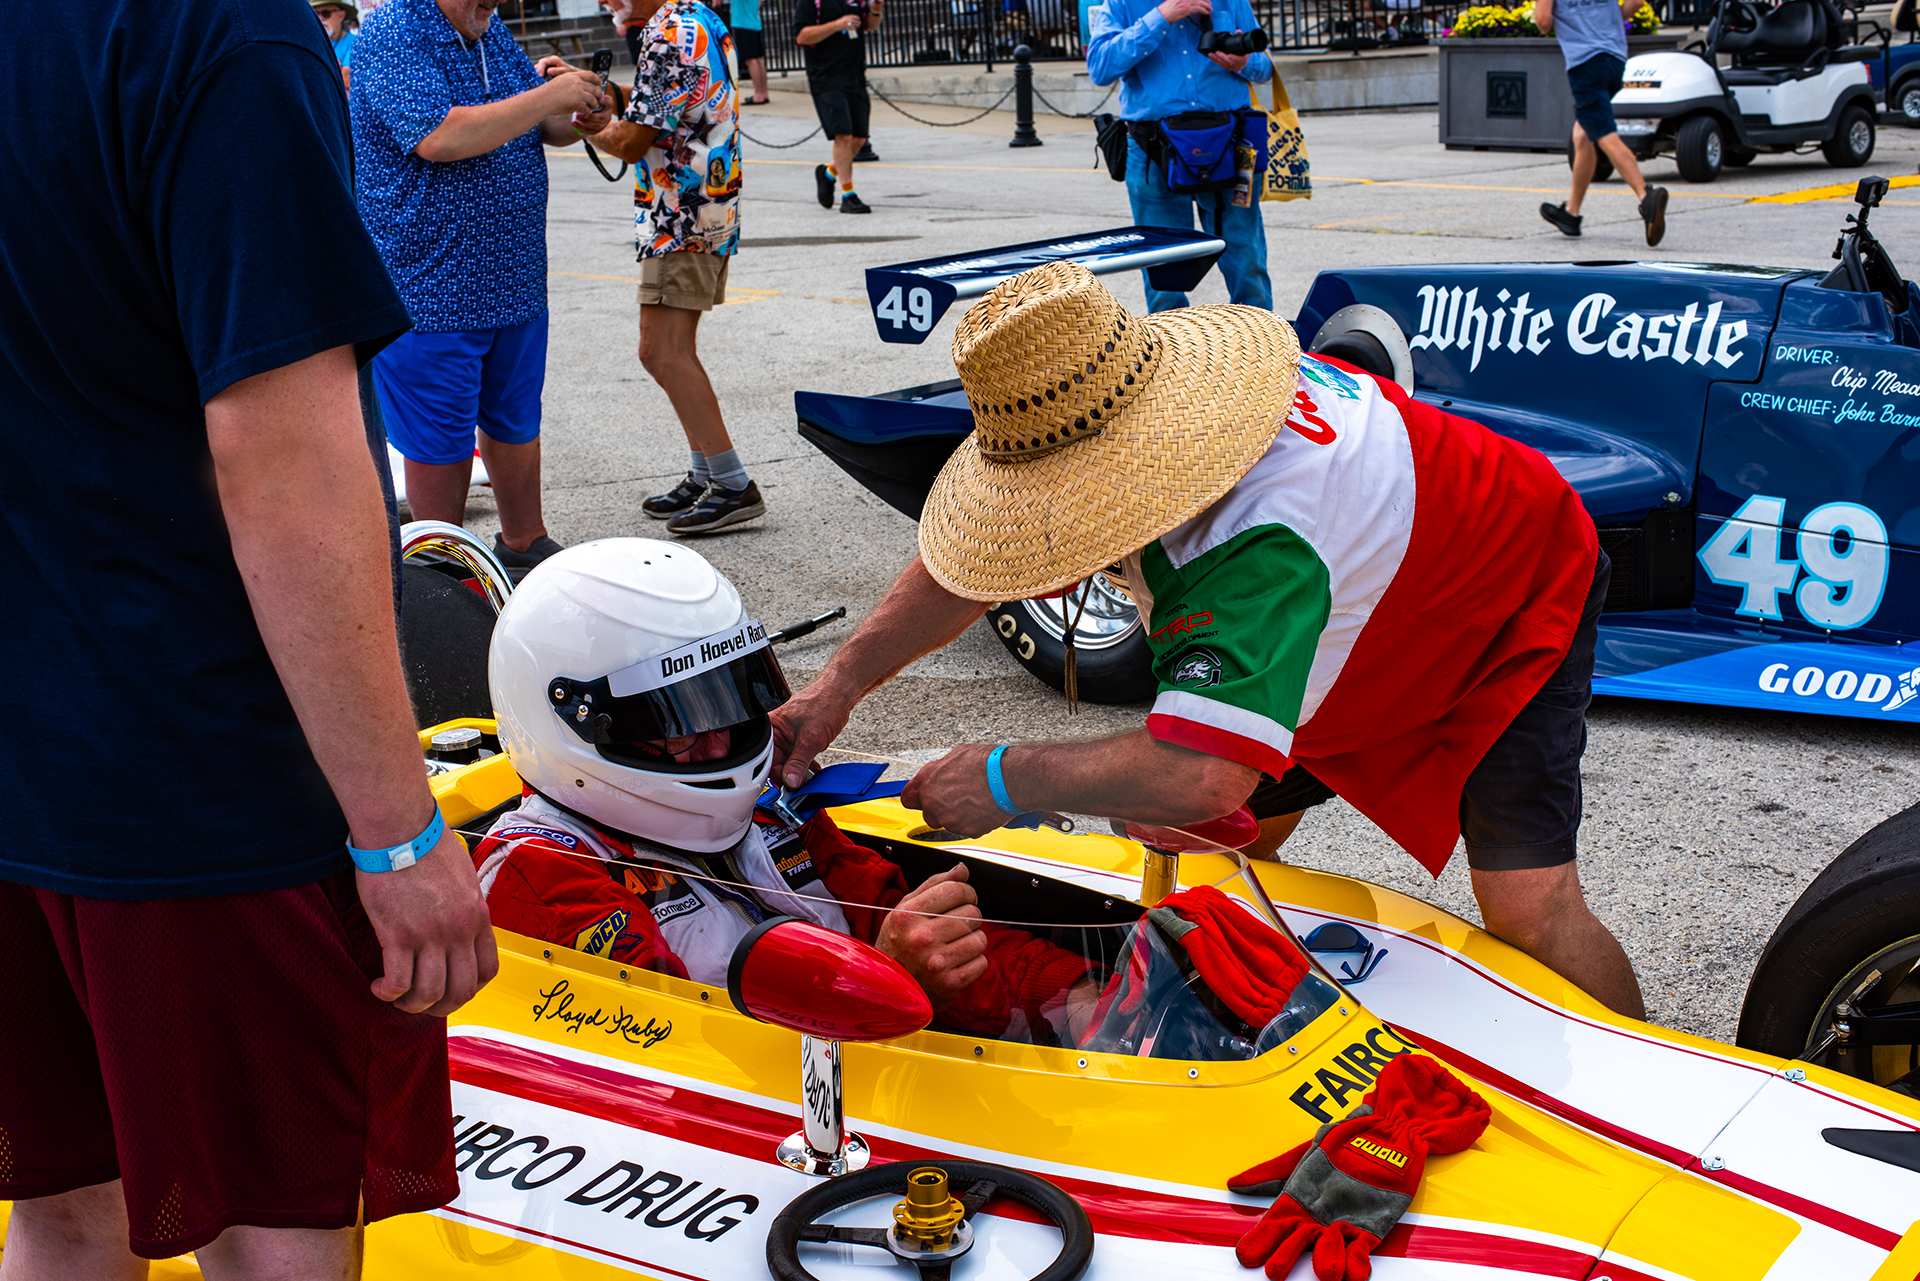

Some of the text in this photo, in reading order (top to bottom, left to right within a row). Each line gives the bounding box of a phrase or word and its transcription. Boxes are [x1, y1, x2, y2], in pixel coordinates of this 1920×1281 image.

[1049, 233, 1145, 251] Valvoline
[901, 257, 998, 276] alvoline
[876, 285, 933, 332] 49
[1409, 284, 1749, 373] White Castle
[1830, 365, 1867, 397] Chip
[1741, 391, 1786, 410] CREW
[1833, 398, 1876, 424] John
[1879, 403, 1920, 428] Barn
[1696, 494, 1890, 631] 49
[1150, 611, 1213, 644] TRD
[1164, 602, 1189, 618] TOYOTA
[661, 654, 695, 678] Don
[700, 629, 747, 664] Hoevel
[501, 827, 577, 846] sparco
[786, 860, 813, 877] TIRE
[533, 980, 673, 1049] Lloyd Ruby
[453, 1114, 760, 1243] IRCO DRUG
